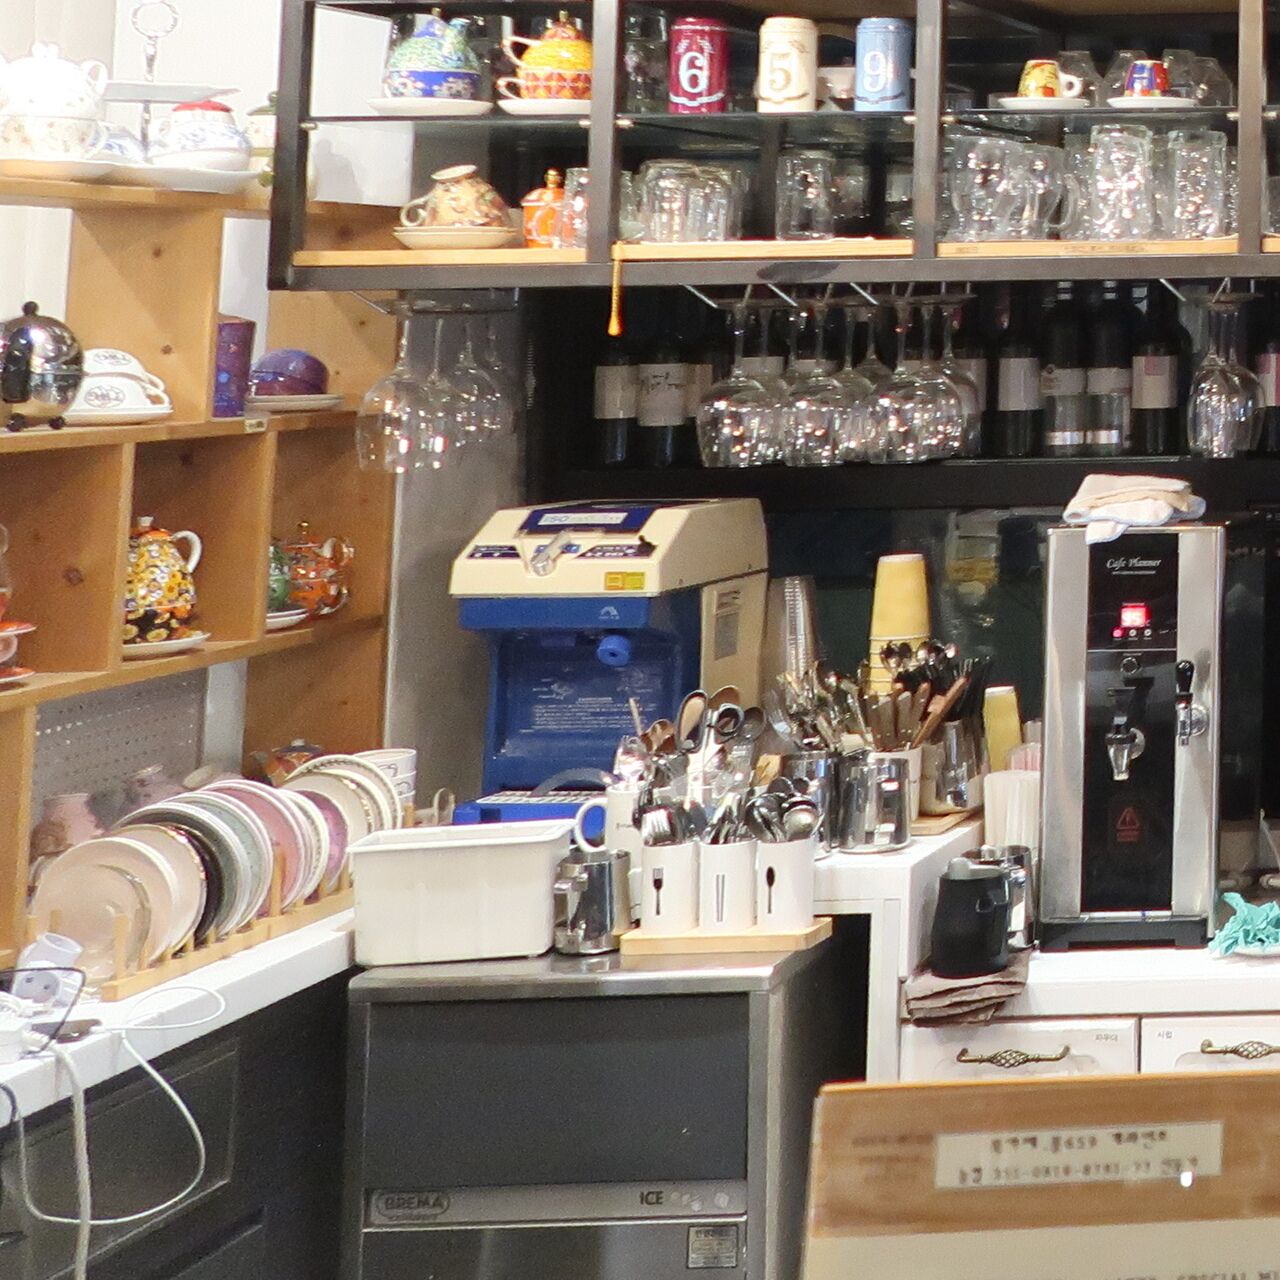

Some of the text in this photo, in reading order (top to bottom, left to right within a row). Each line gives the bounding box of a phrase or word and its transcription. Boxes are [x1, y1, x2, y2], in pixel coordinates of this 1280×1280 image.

[679, 52, 709, 94] 6
[766, 52, 794, 92] 5
[862, 51, 889, 93] 9
[1107, 557, 1126, 570] Cafe
[639, 1190, 664, 1206] ICE
